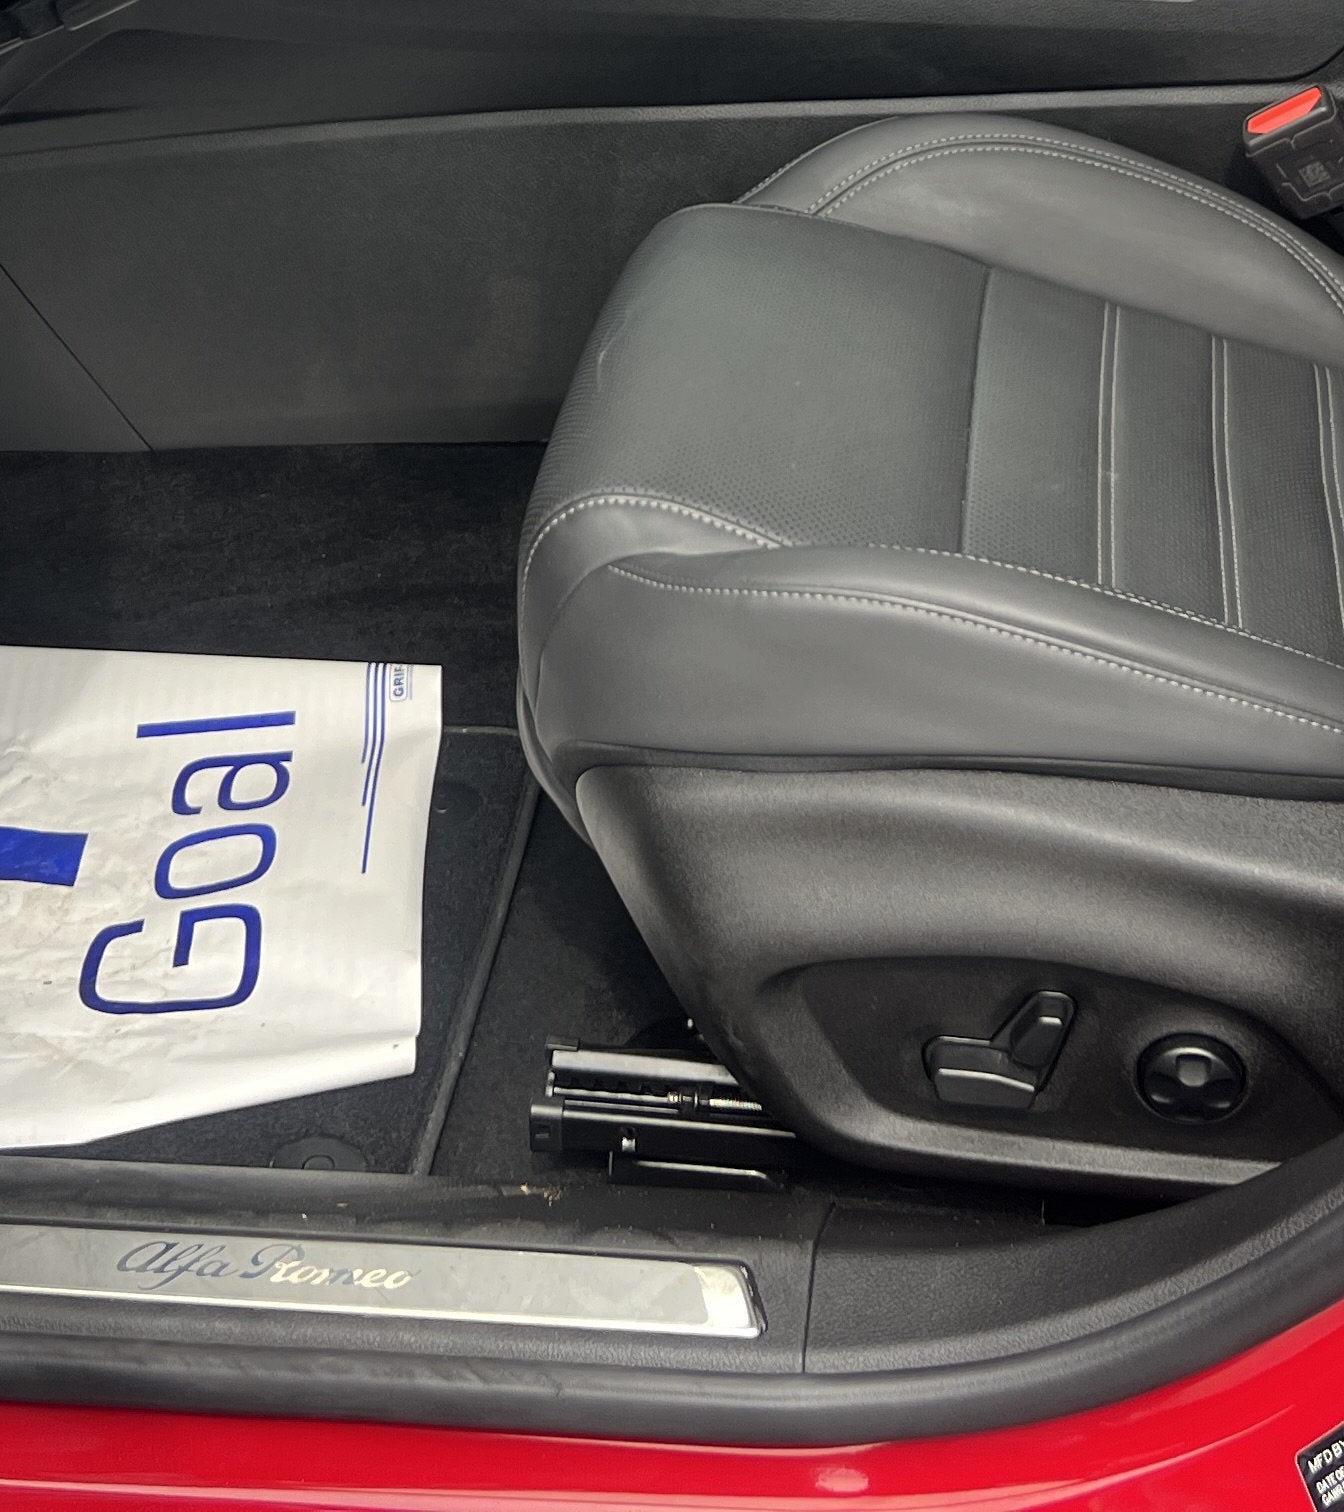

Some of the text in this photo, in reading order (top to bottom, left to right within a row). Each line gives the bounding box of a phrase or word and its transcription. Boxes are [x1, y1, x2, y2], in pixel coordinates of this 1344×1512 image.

[79, 710, 296, 1015] Goal
[116, 1240, 421, 1291] Alfa Romeo
